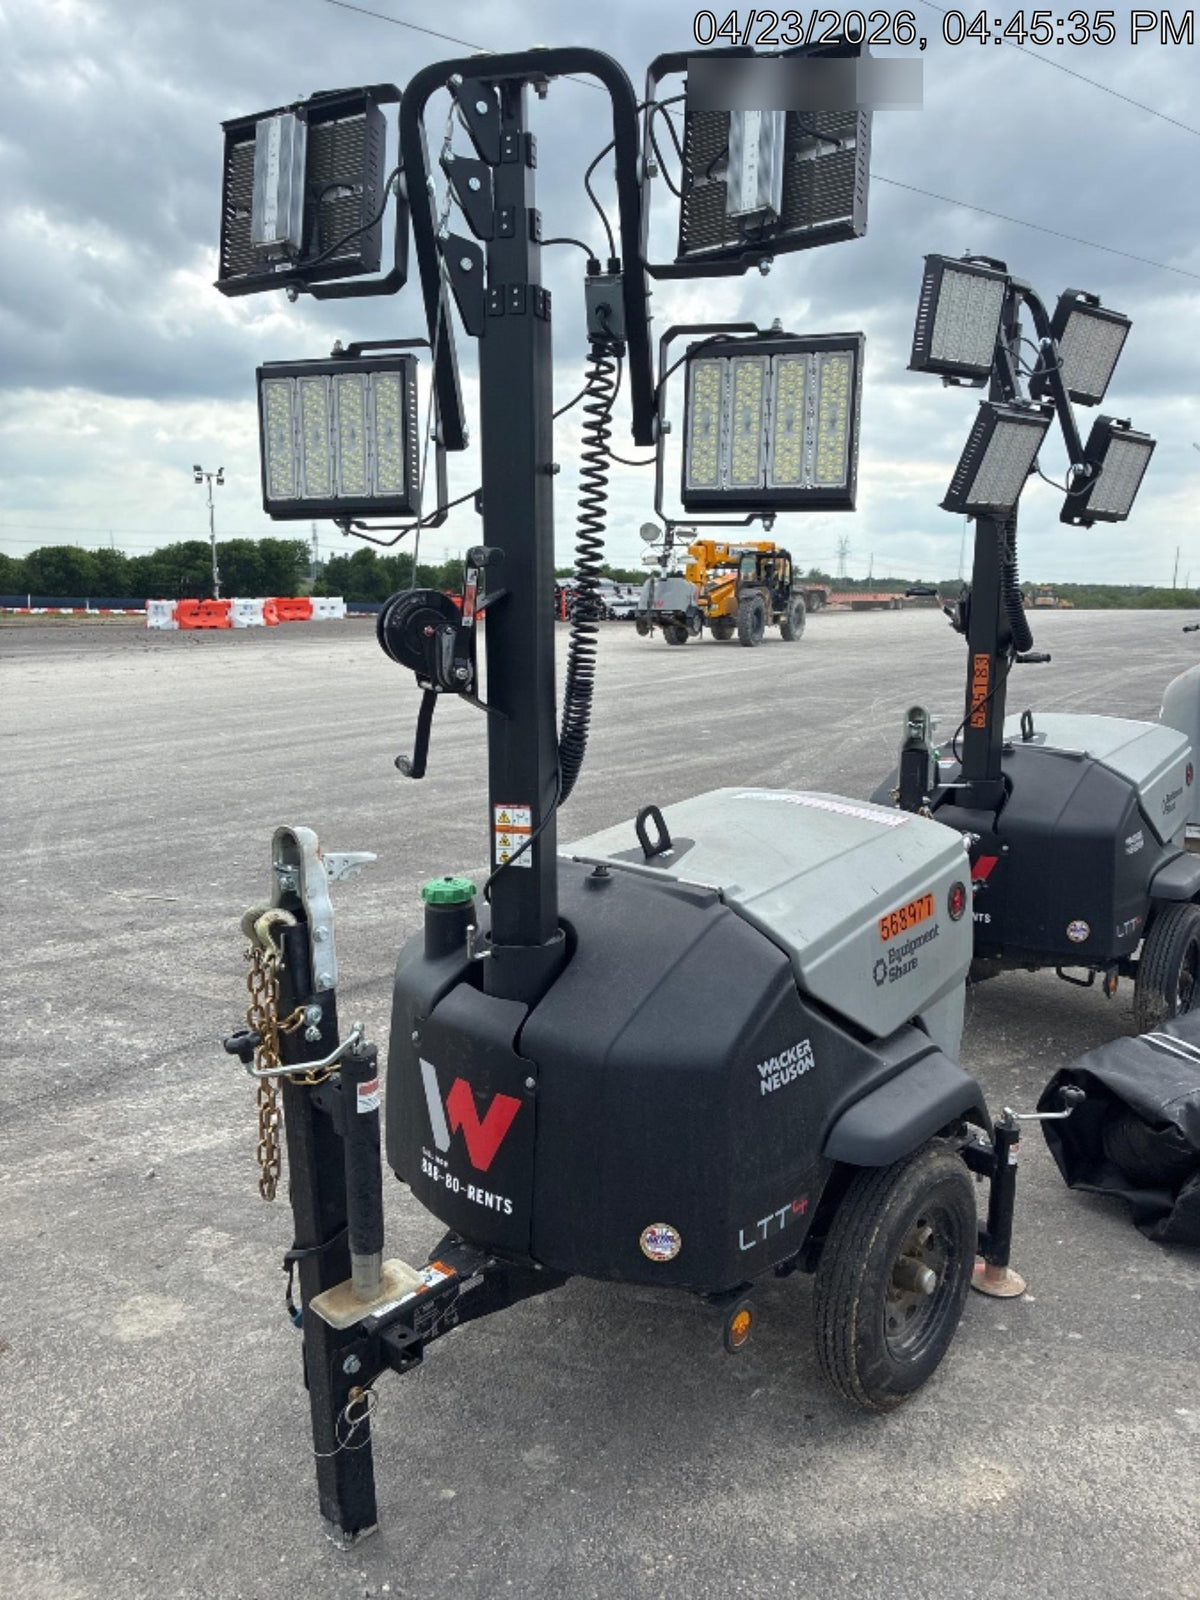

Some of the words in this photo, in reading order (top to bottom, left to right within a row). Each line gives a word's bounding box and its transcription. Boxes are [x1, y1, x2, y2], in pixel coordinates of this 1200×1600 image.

[880, 893, 933, 942] 568977
[888, 923, 940, 965] Equipment
[888, 958, 919, 983] Share
[757, 1038, 812, 1078] WACKER
[760, 1052, 815, 1096] NEUSON
